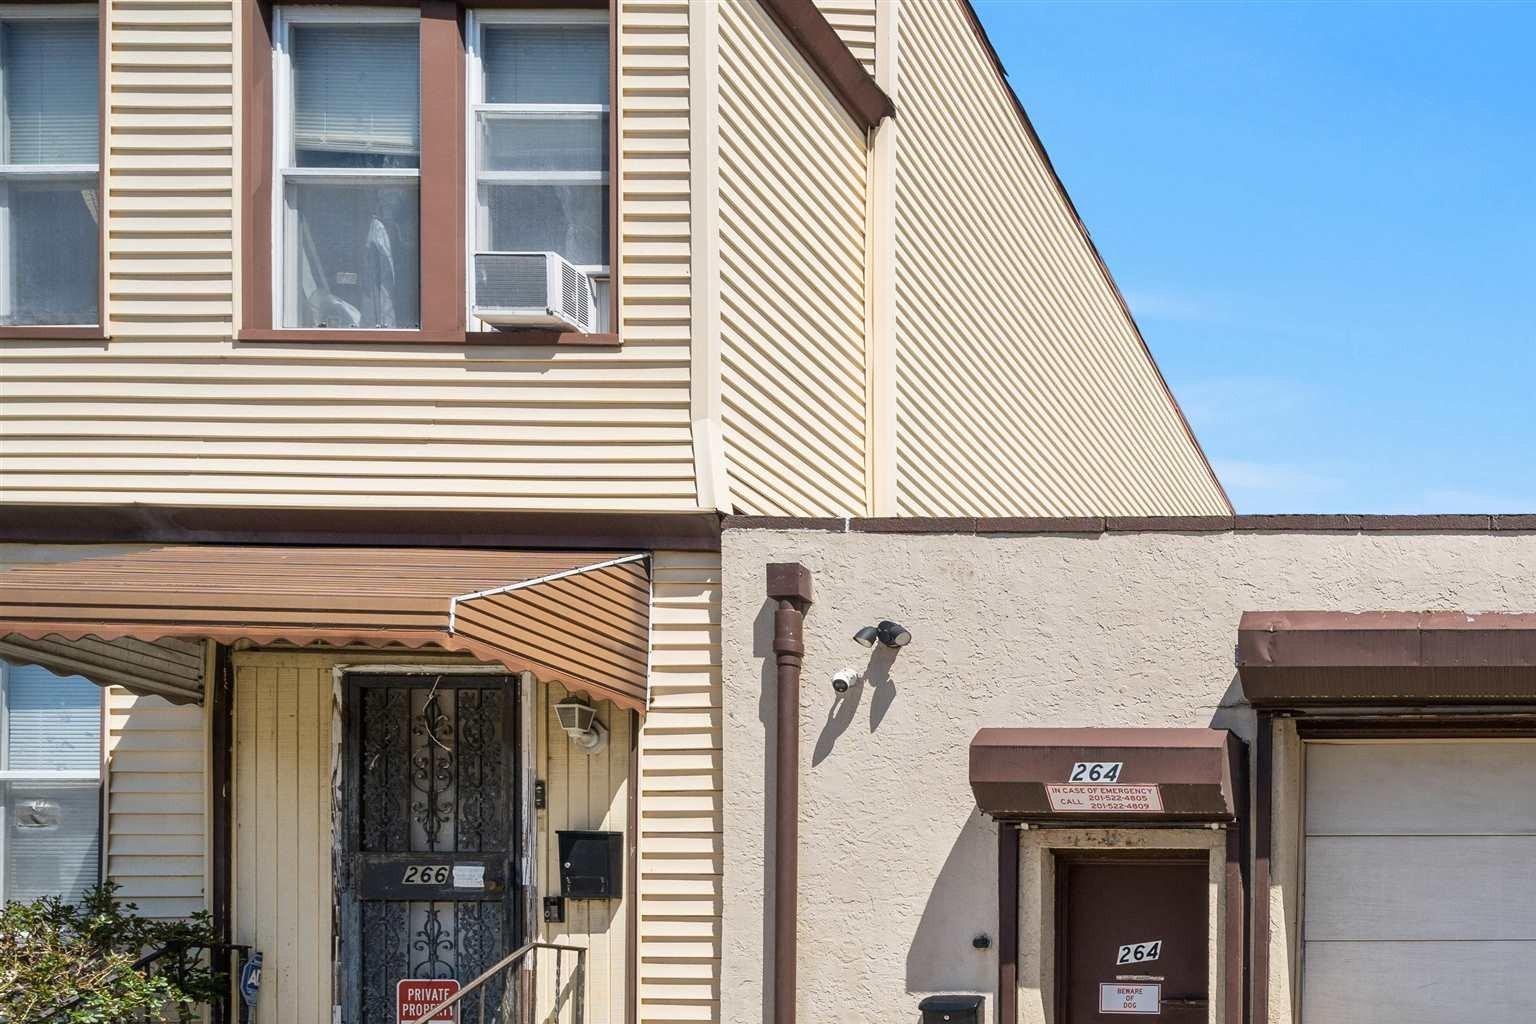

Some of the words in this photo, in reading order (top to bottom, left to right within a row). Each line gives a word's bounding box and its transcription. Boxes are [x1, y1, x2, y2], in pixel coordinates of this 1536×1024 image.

[1072, 764, 1120, 781] 264
[404, 867, 448, 883] 266
[1119, 942, 1160, 963] 264
[408, 988, 450, 1001] PRIVATE
